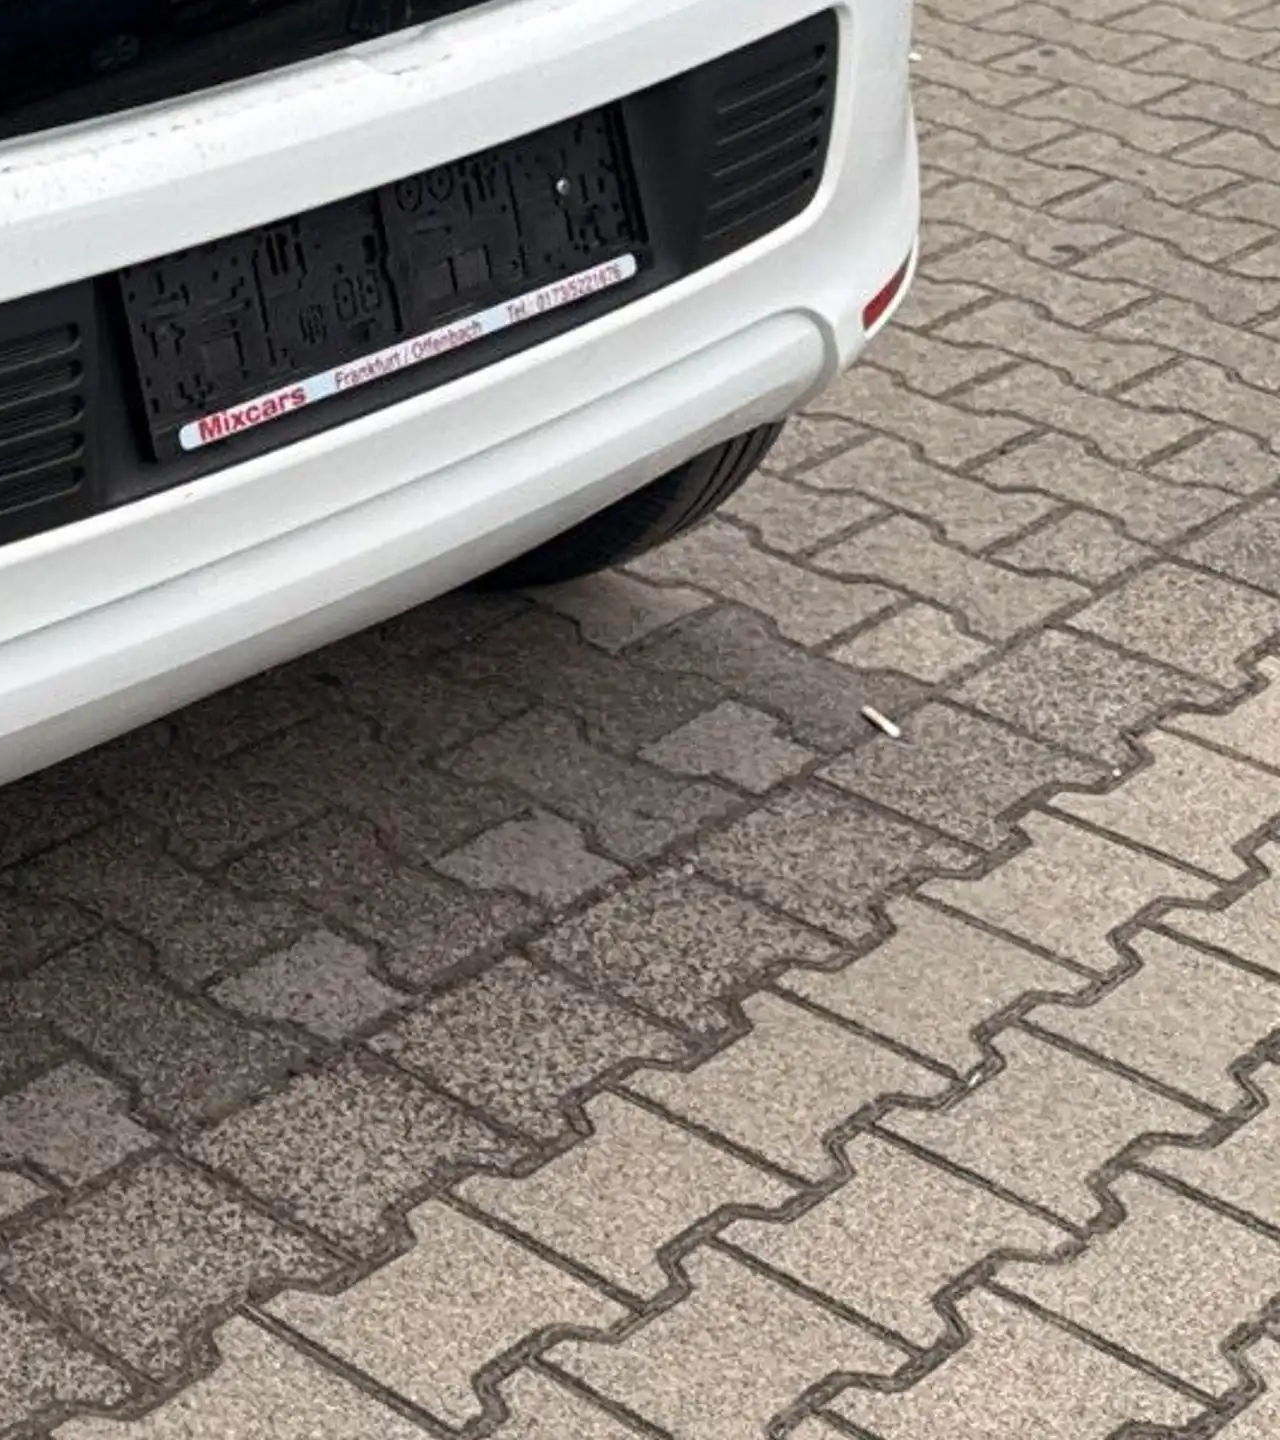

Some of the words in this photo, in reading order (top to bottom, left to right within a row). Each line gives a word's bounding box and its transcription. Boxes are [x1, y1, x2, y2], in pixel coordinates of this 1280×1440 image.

[197, 386, 307, 442] Mixcars
[334, 351, 401, 390] Frankfurt
[410, 320, 483, 359] Offenbach
